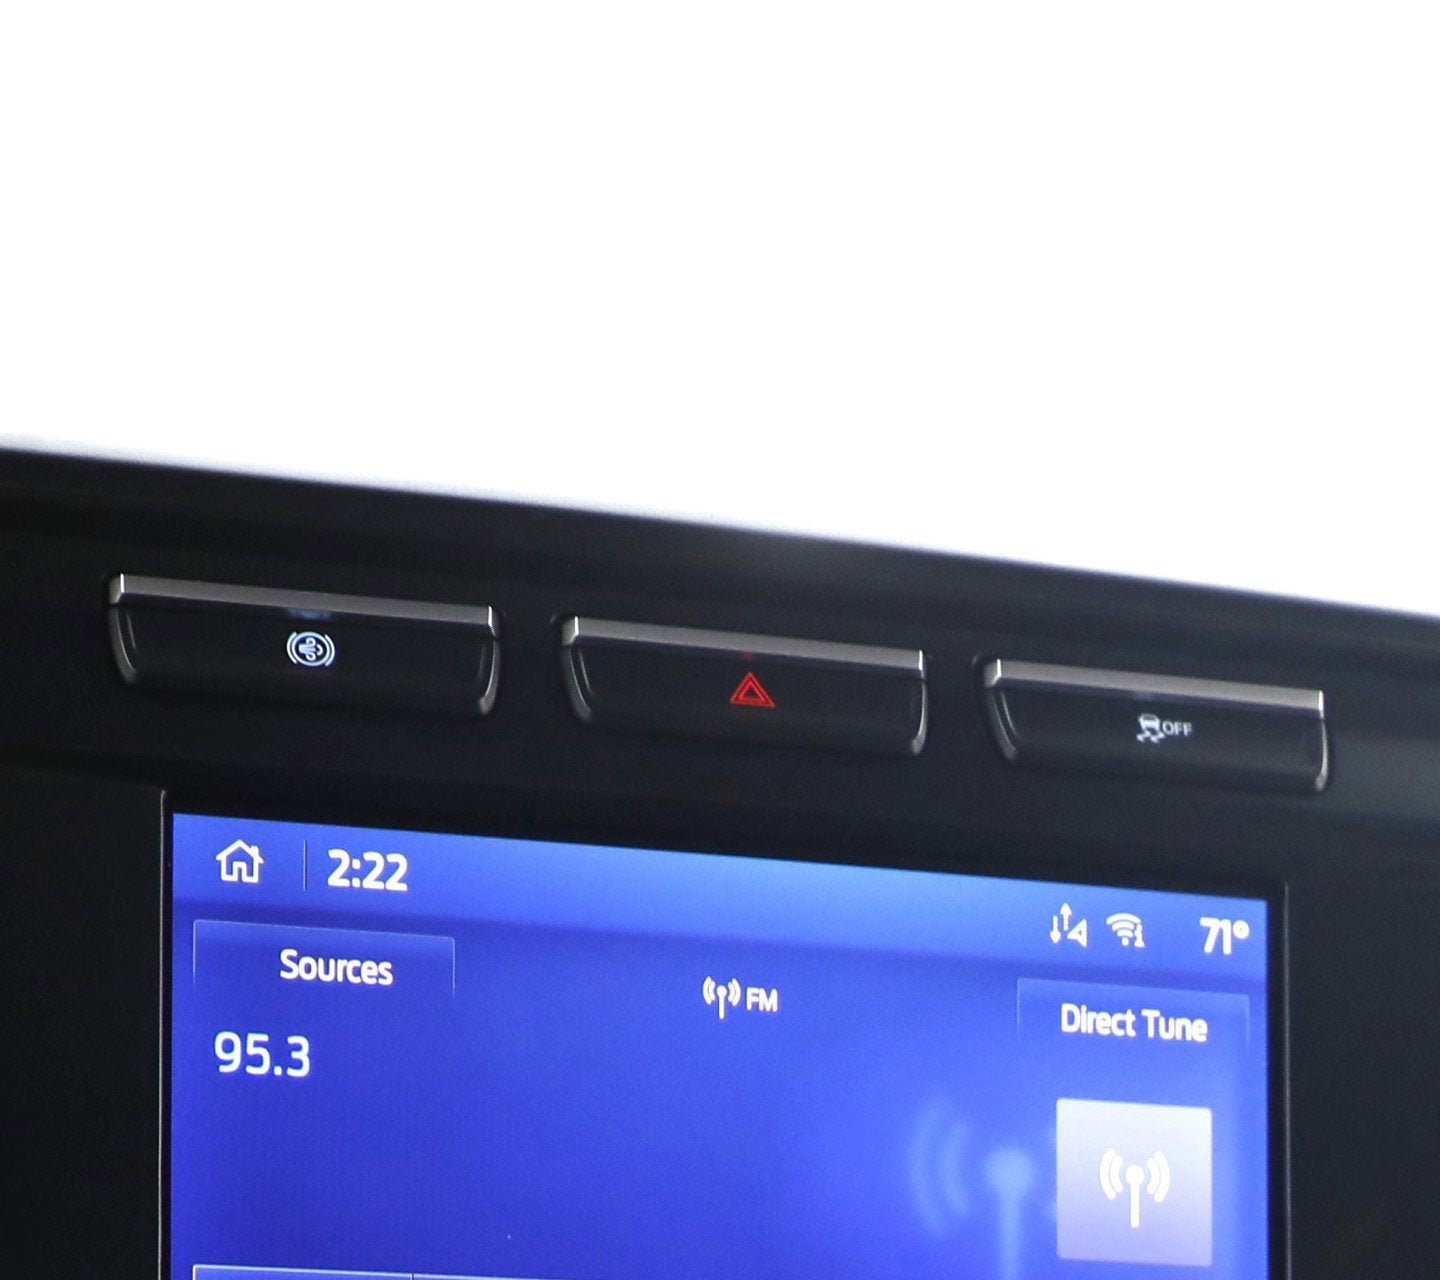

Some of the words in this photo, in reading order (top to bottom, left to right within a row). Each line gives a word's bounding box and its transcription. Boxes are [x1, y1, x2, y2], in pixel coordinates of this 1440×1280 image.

[1162, 720, 1193, 737] OFF
[327, 848, 408, 892] 2:22
[279, 948, 394, 986] Sources
[746, 987, 778, 1013] FM
[1061, 1003, 1137, 1038] Direct
[1141, 1008, 1209, 1043] Tune
[214, 1031, 310, 1078] 95.3
